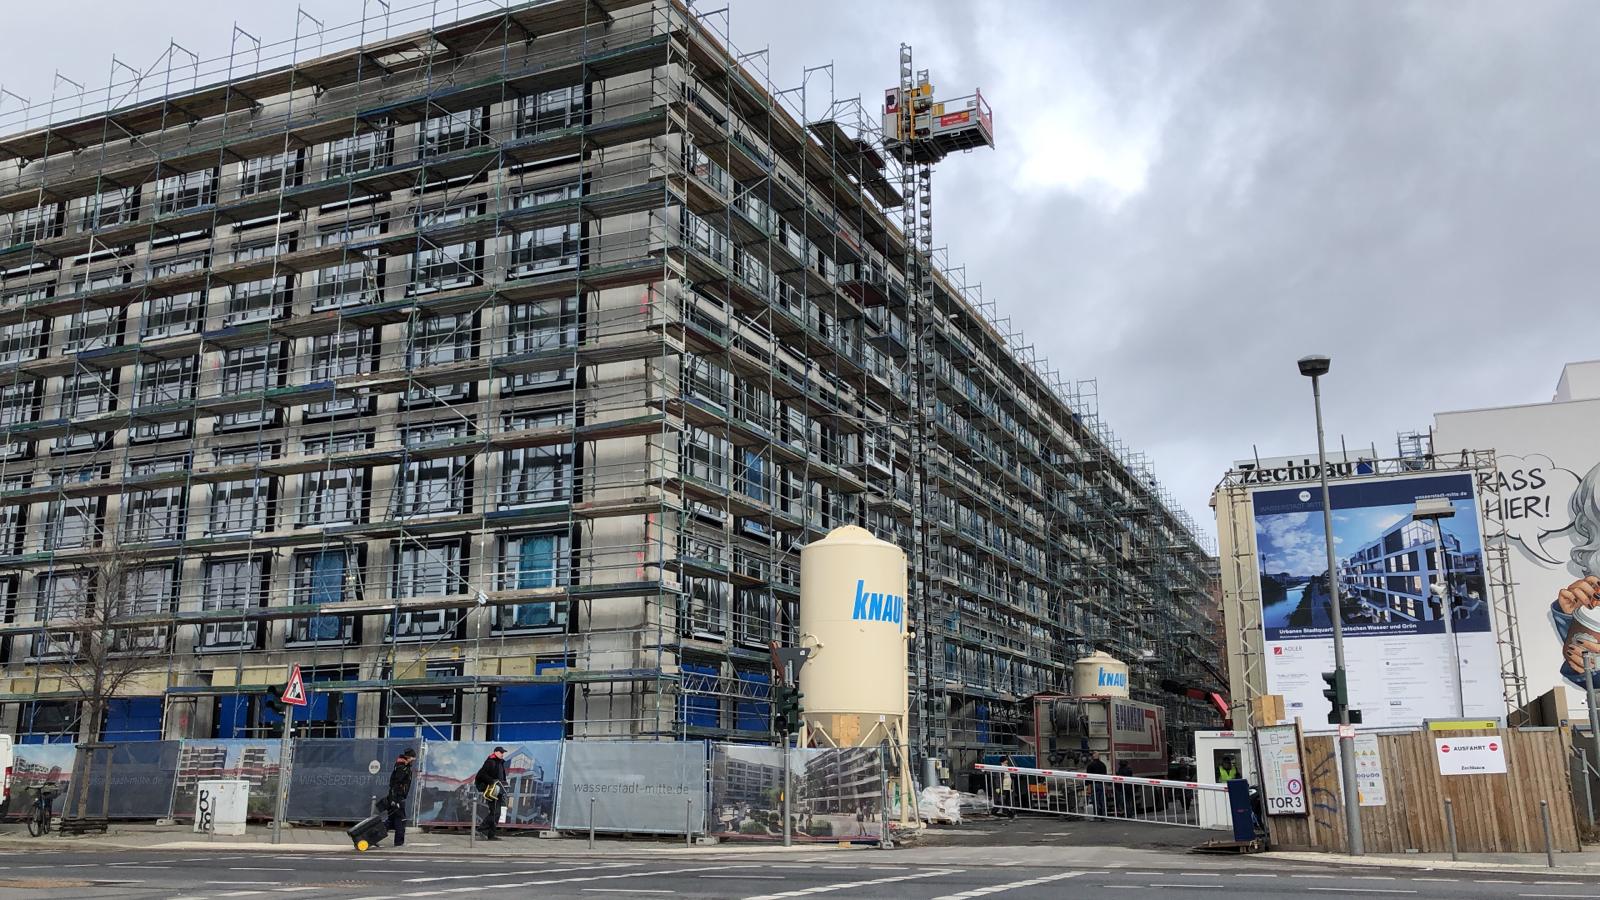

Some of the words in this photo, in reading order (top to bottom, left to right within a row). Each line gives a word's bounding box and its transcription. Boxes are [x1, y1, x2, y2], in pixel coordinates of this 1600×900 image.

[1239, 459, 1351, 483] Zechbau
[1485, 496, 1550, 520] HIER!
[573, 781, 689, 795] wasserstadt-mitte.de
[1269, 797, 1292, 808] TOR
[1295, 797, 1302, 808] 3
